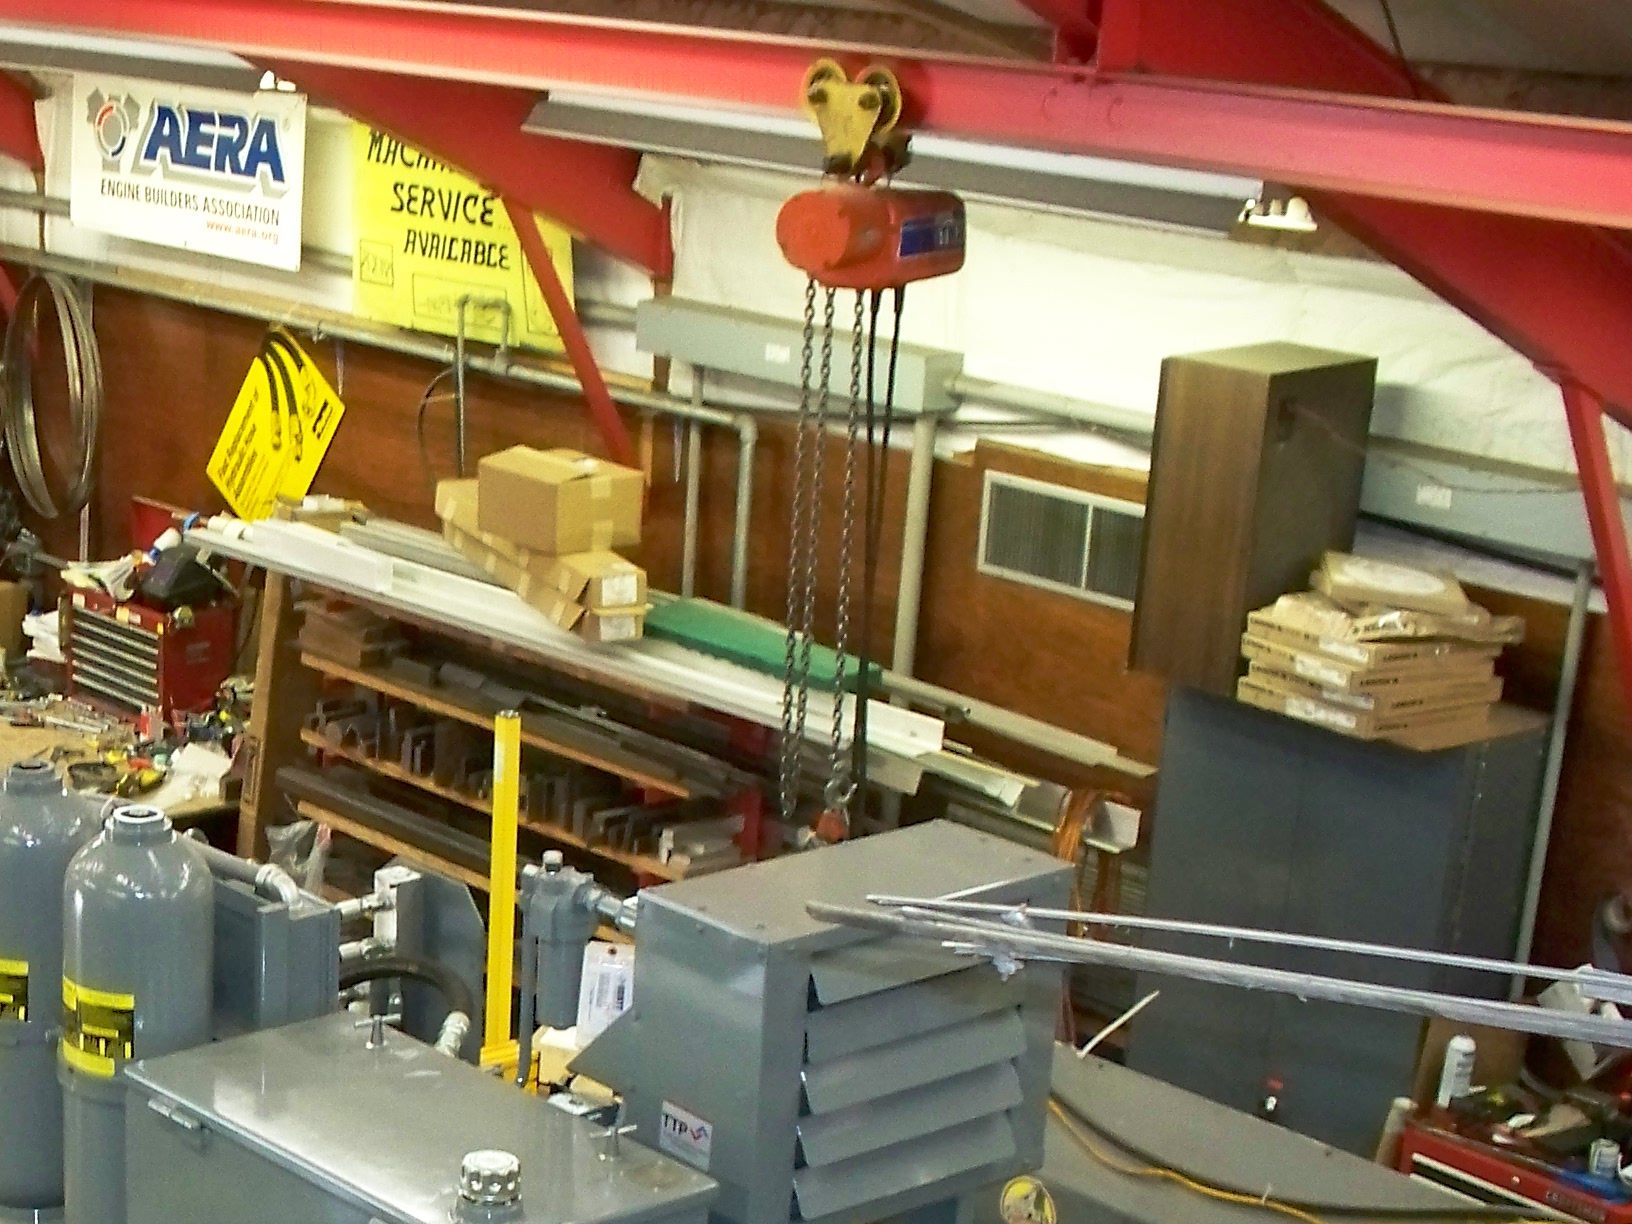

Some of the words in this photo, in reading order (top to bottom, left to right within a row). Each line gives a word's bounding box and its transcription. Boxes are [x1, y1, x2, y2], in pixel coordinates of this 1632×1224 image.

[142, 103, 287, 185] AERA
[100, 178, 141, 201] ENGINE
[144, 185, 199, 212] BUILDERS
[202, 196, 280, 226] ASSOCIATION
[390, 181, 495, 227] SERVICE
[206, 219, 279, 245] www.aera.org
[404, 229, 511, 271] AVAILABLE
